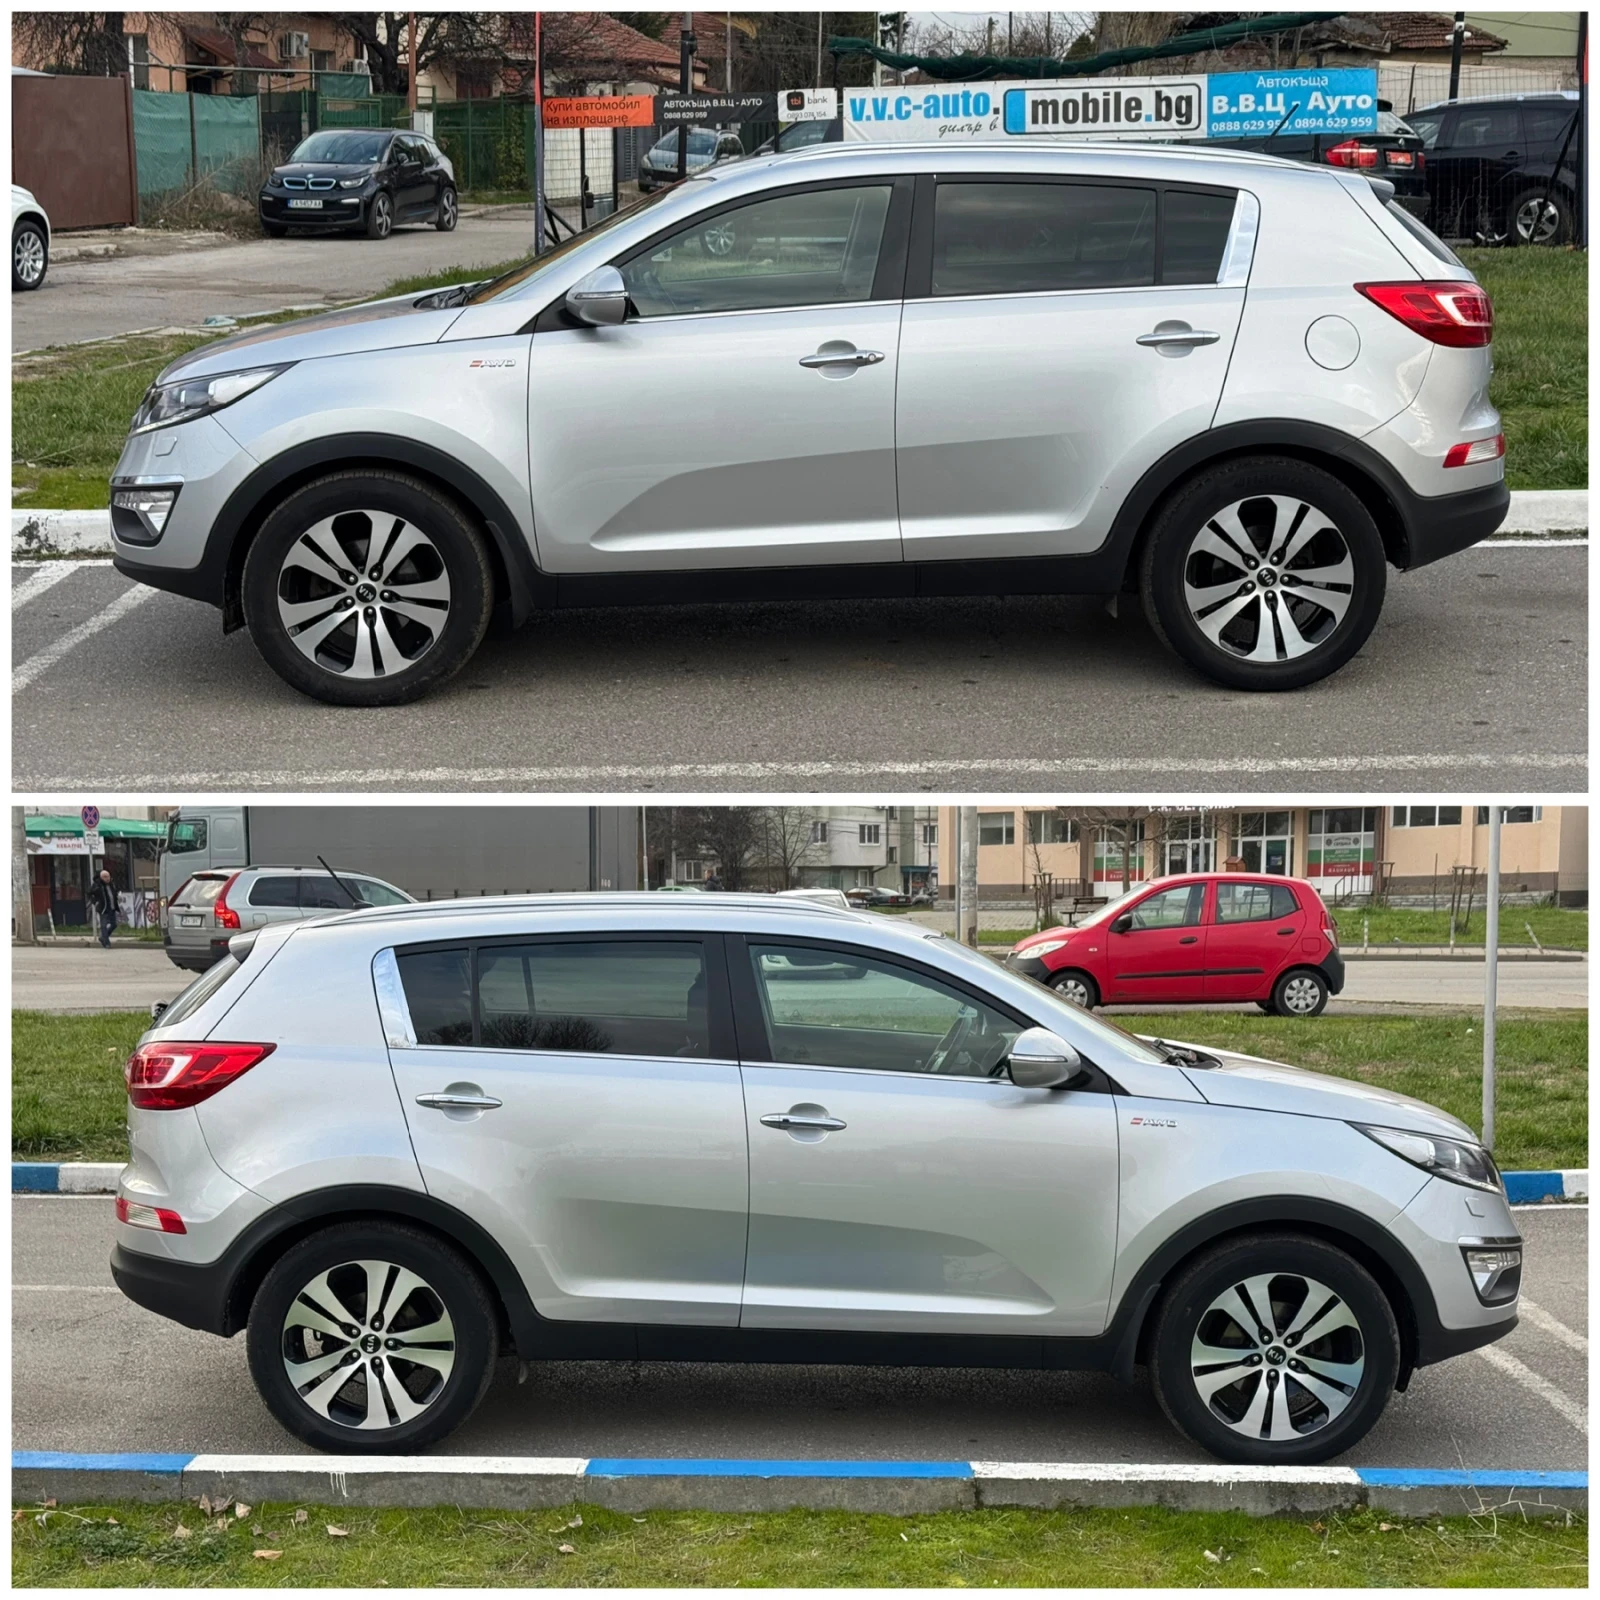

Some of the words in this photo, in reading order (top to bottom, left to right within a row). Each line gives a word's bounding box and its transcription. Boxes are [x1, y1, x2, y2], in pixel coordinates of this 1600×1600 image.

[1256, 76, 1328, 88] Автокъща
[546, 101, 573, 114] Купи
[576, 100, 640, 111] автомобил
[663, 99, 711, 108] АВТОКЪЩА
[712, 98, 735, 107] В.В.Ц
[741, 98, 763, 106] АУТО
[807, 96, 828, 105] bank
[1031, 90, 1193, 126] mobile.bg
[1212, 92, 1286, 115] В.В.Ц
[1307, 91, 1373, 114] Ауто
[548, 115, 560, 125] на
[563, 114, 629, 126] изплащане
[1212, 121, 1241, 132] 0888
[1242, 120, 1265, 131] 629
[1295, 117, 1324, 129] 0894
[1326, 116, 1349, 128] 629
[1350, 115, 1373, 128] 959
[938, 121, 983, 138] дилър
[1260, 569, 1274, 585] KIA
[366, 1335, 375, 1352] KIA
[1267, 1349, 1284, 1363] KIA
